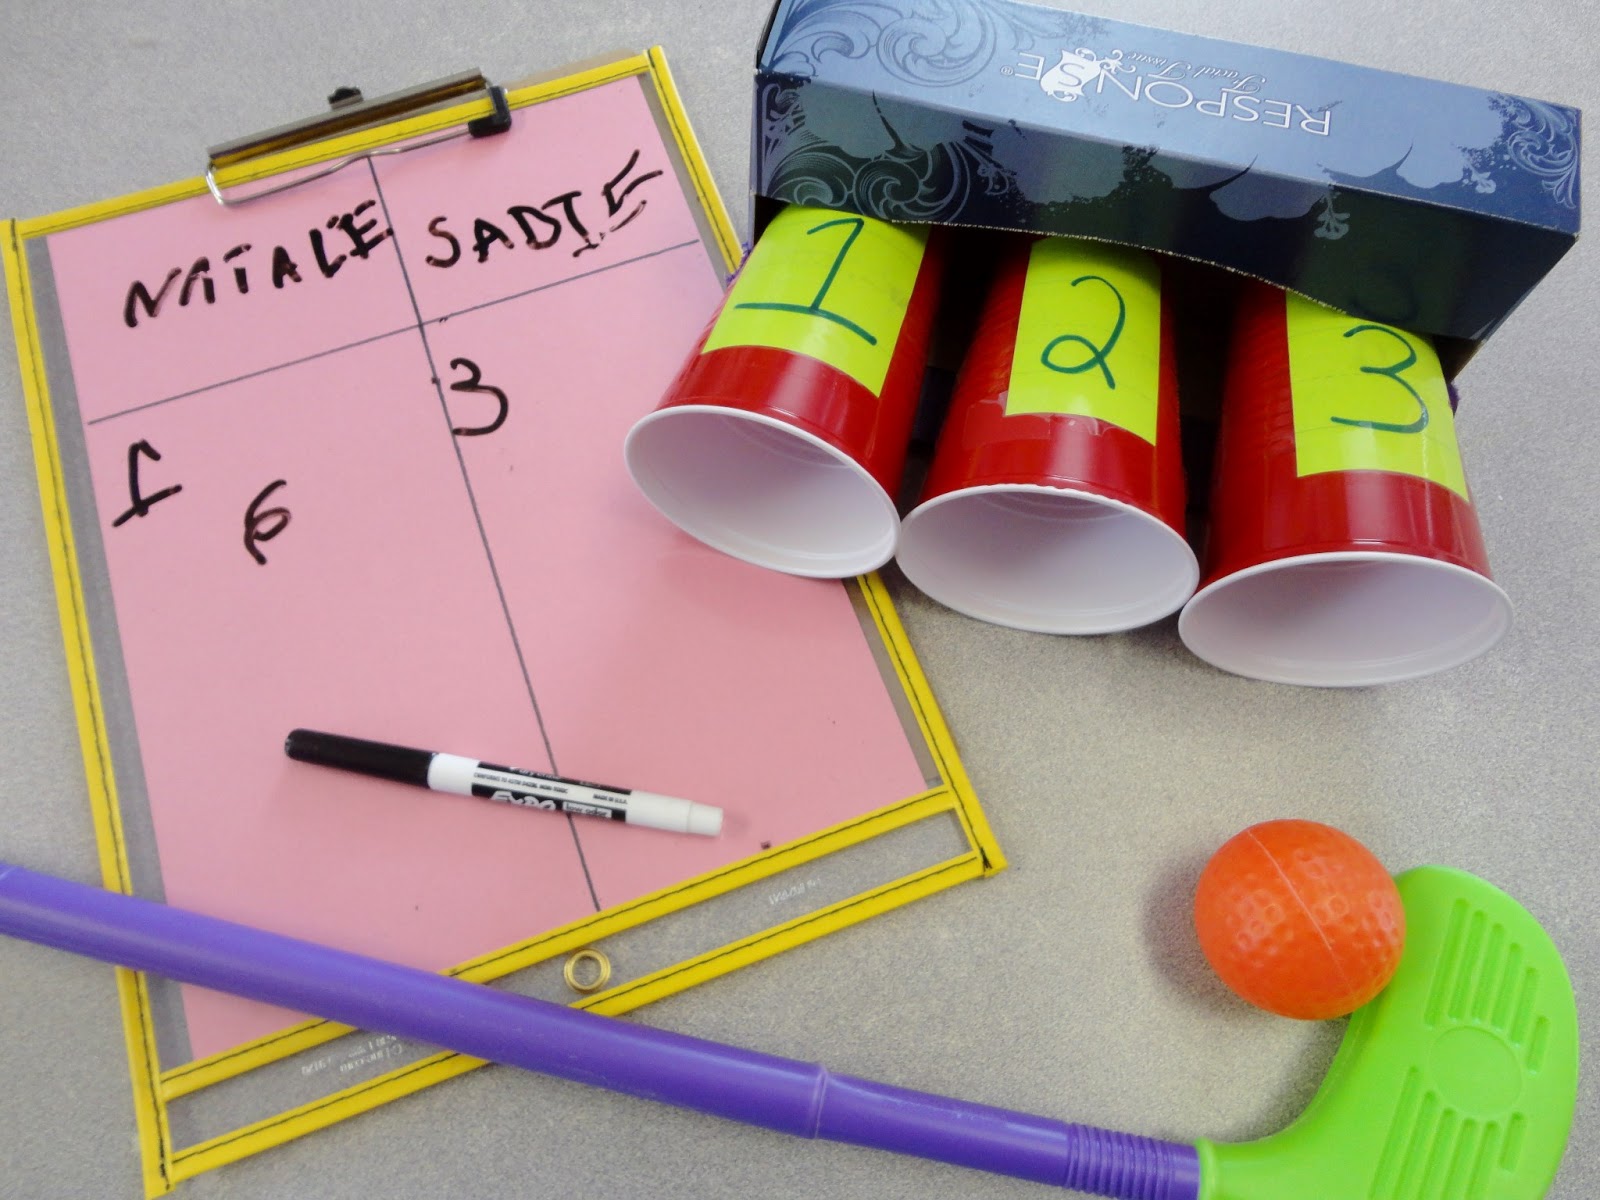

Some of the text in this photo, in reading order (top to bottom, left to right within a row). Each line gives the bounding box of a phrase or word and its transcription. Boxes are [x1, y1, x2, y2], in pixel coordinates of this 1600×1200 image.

[1126, 51, 1266, 95] Facial Tissue
[734, 217, 878, 346] 1
[1040, 274, 1126, 390] 2
[1329, 324, 1430, 434] 3
[449, 357, 510, 437] 3
[243, 479, 292, 565] 6
